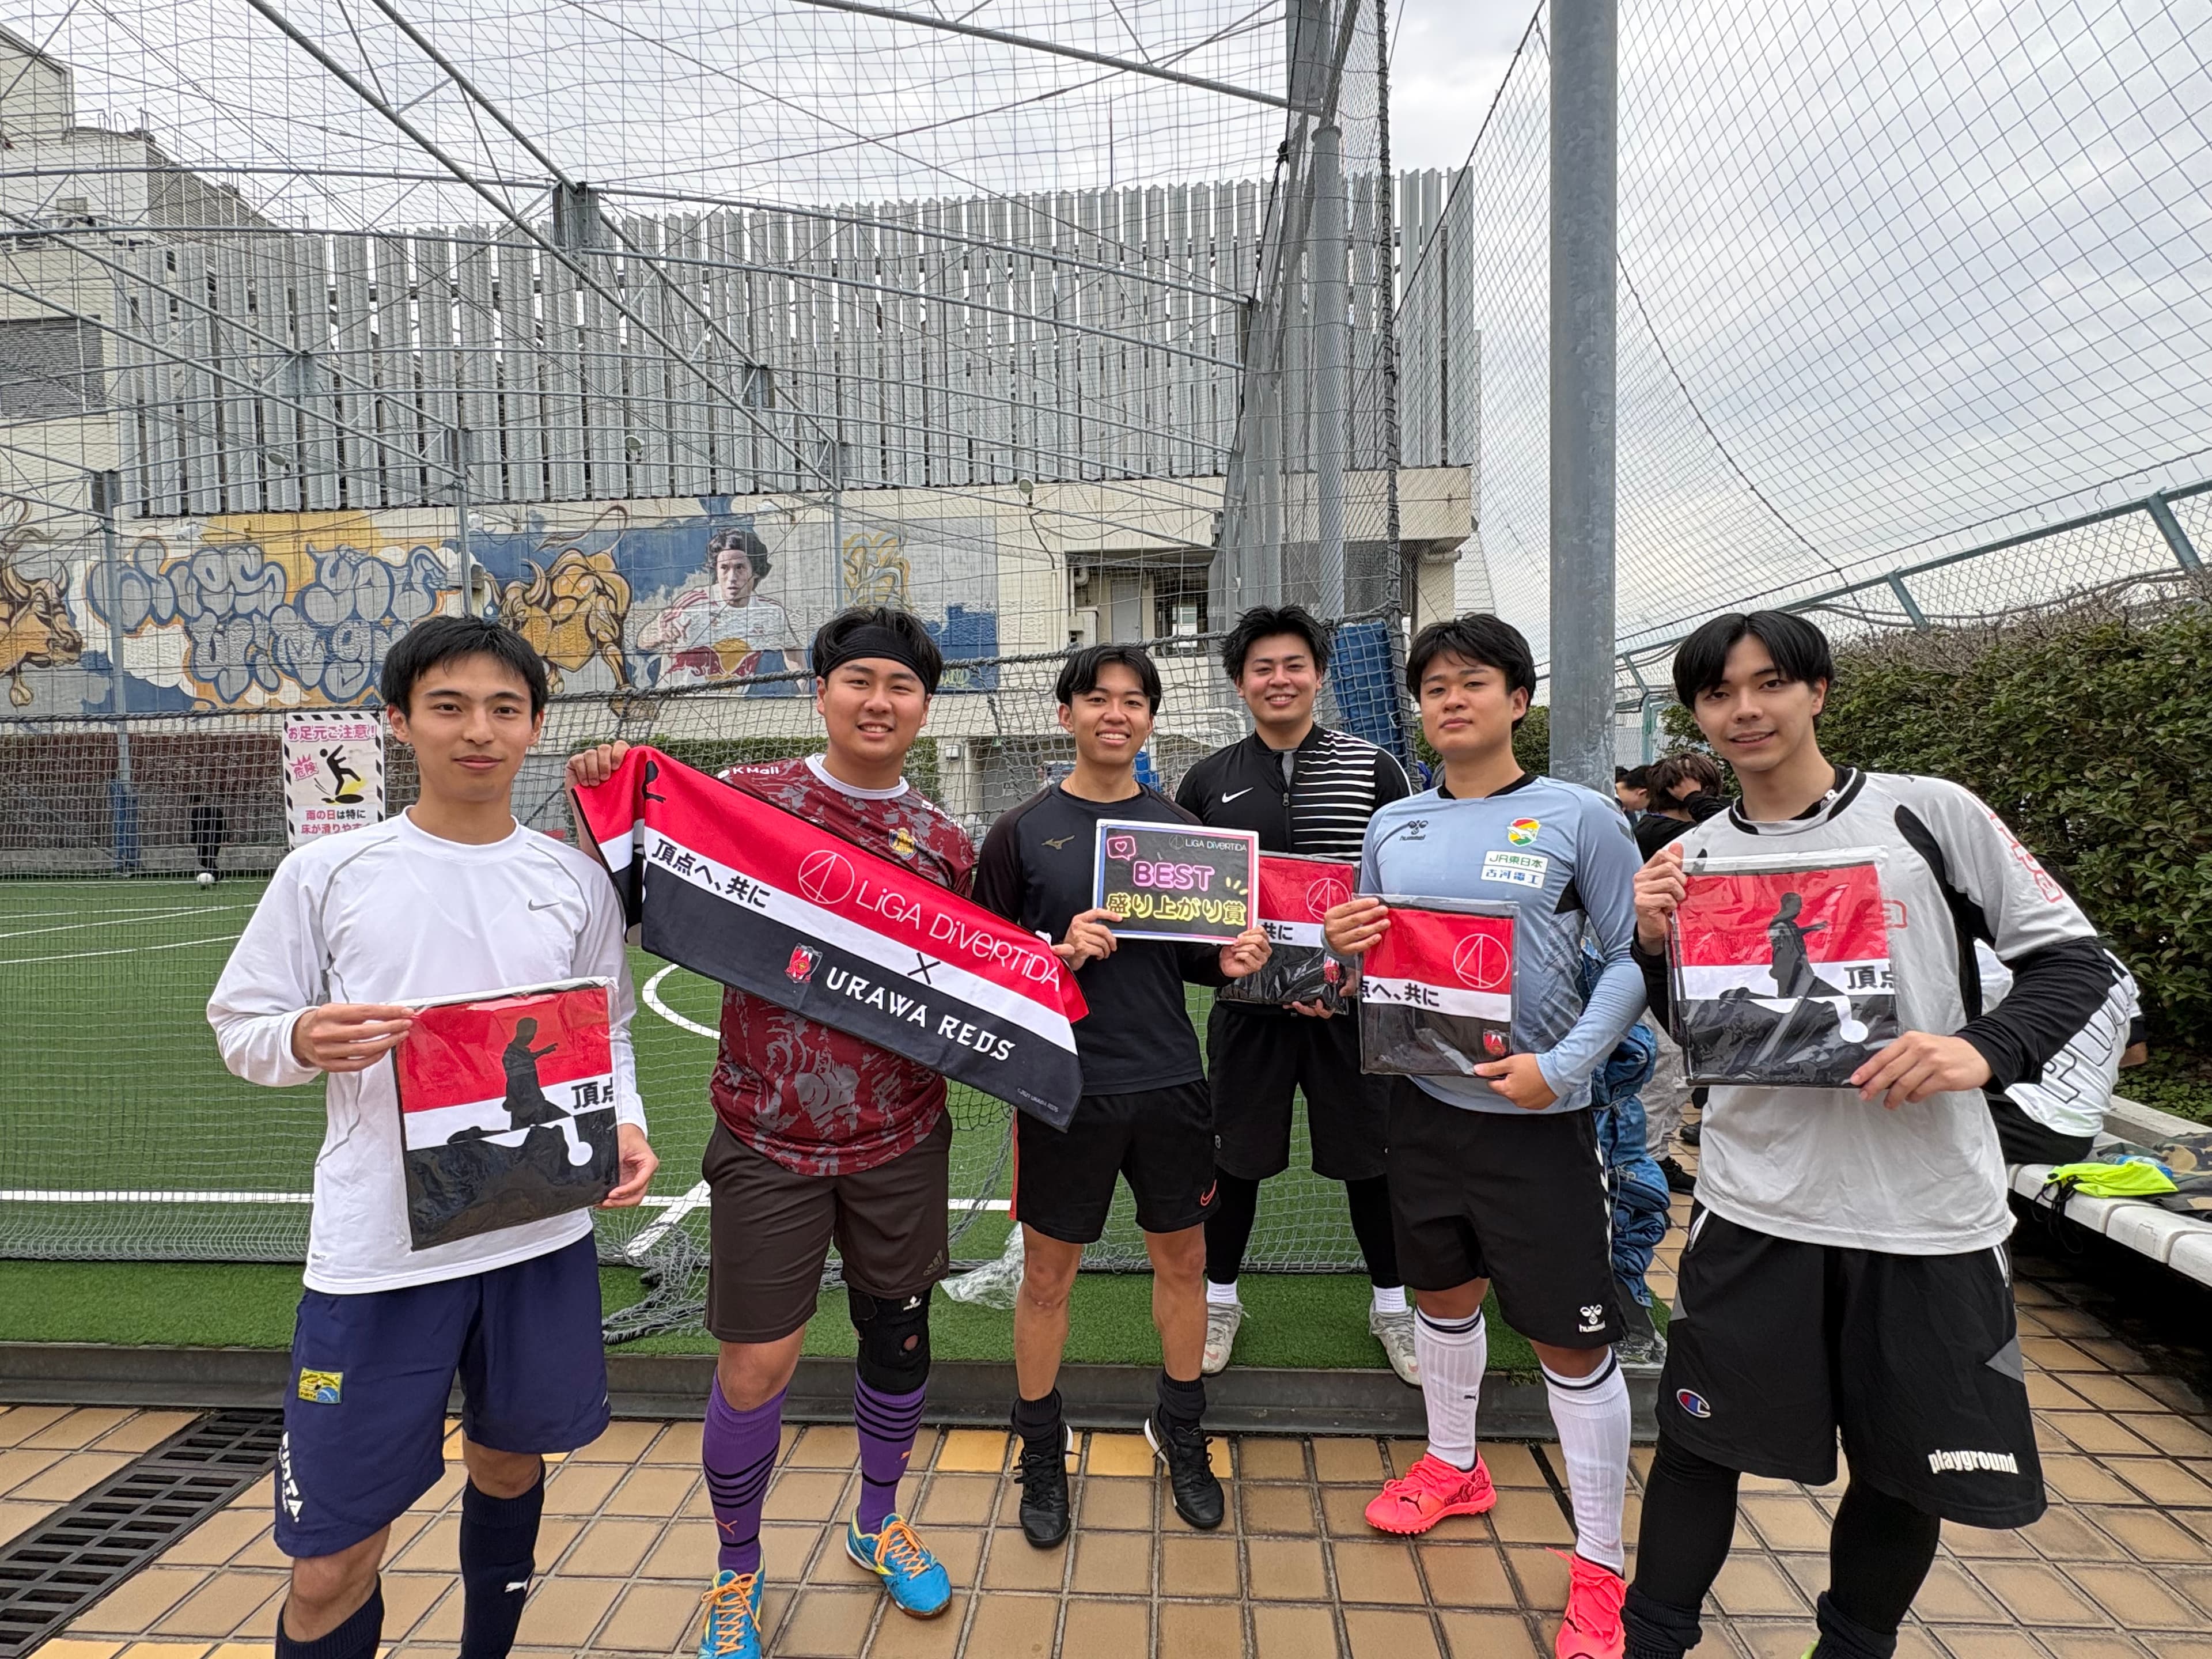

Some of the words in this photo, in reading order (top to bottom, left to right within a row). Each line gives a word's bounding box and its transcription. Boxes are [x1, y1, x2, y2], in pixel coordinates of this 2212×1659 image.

[294, 762, 319, 780] 危険
[306, 809, 366, 820] 雨の日は特に
[652, 838, 771, 908] 頂点へ、共に
[1133, 860, 1215, 892] BEST
[1489, 854, 1543, 869] JR東日本
[1106, 892, 1247, 926] 盛り上がり賞
[826, 967, 927, 1028] URAWA
[938, 1014, 1016, 1061] REDS
[1927, 1449, 2019, 1475] playground
